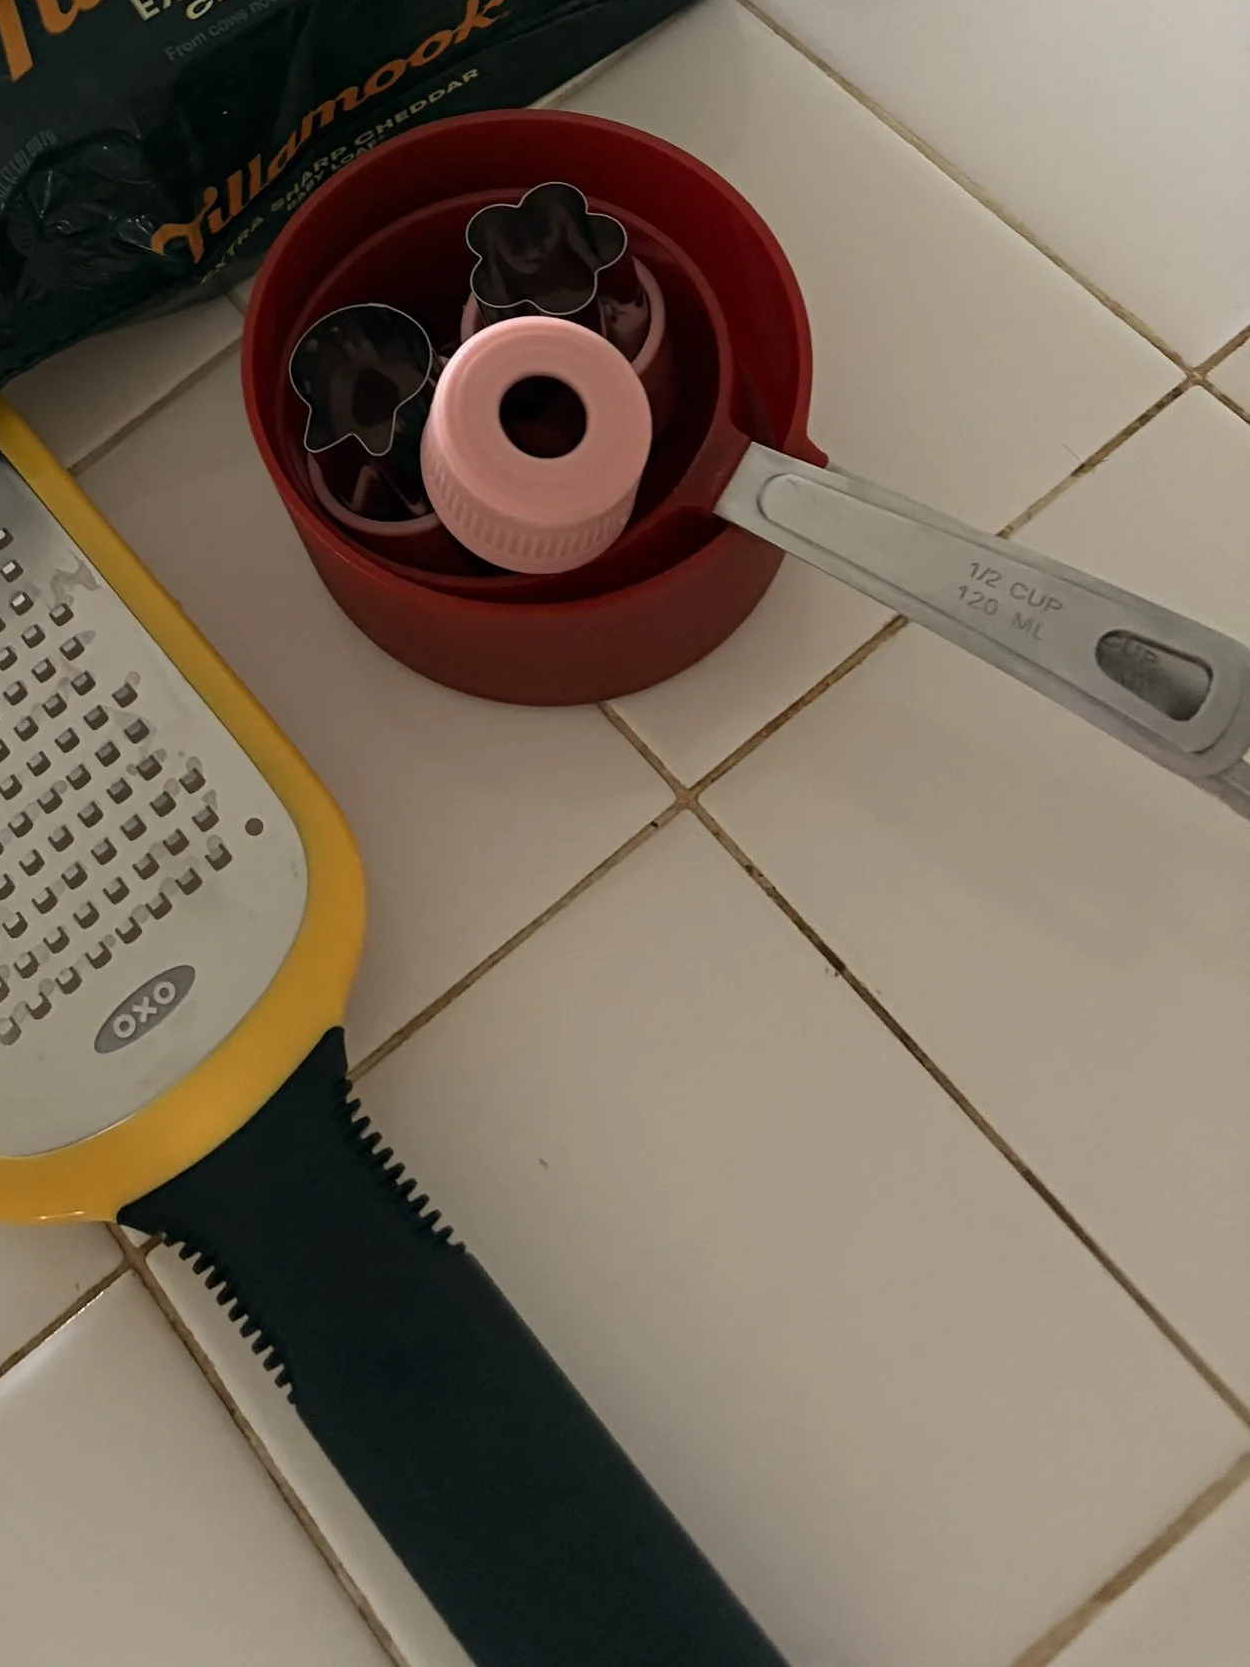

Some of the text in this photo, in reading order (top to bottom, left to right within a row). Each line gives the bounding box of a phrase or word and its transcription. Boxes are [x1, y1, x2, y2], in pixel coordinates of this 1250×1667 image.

[163, 31, 208, 63] From
[208, 9, 248, 36] cows
[271, 146, 347, 212] SHARP
[354, 68, 480, 146] CHEDDAR
[957, 584, 1045, 642] 120 ML
[969, 562, 1065, 613] 1/2 CUP
[112, 980, 177, 1040] OXO
